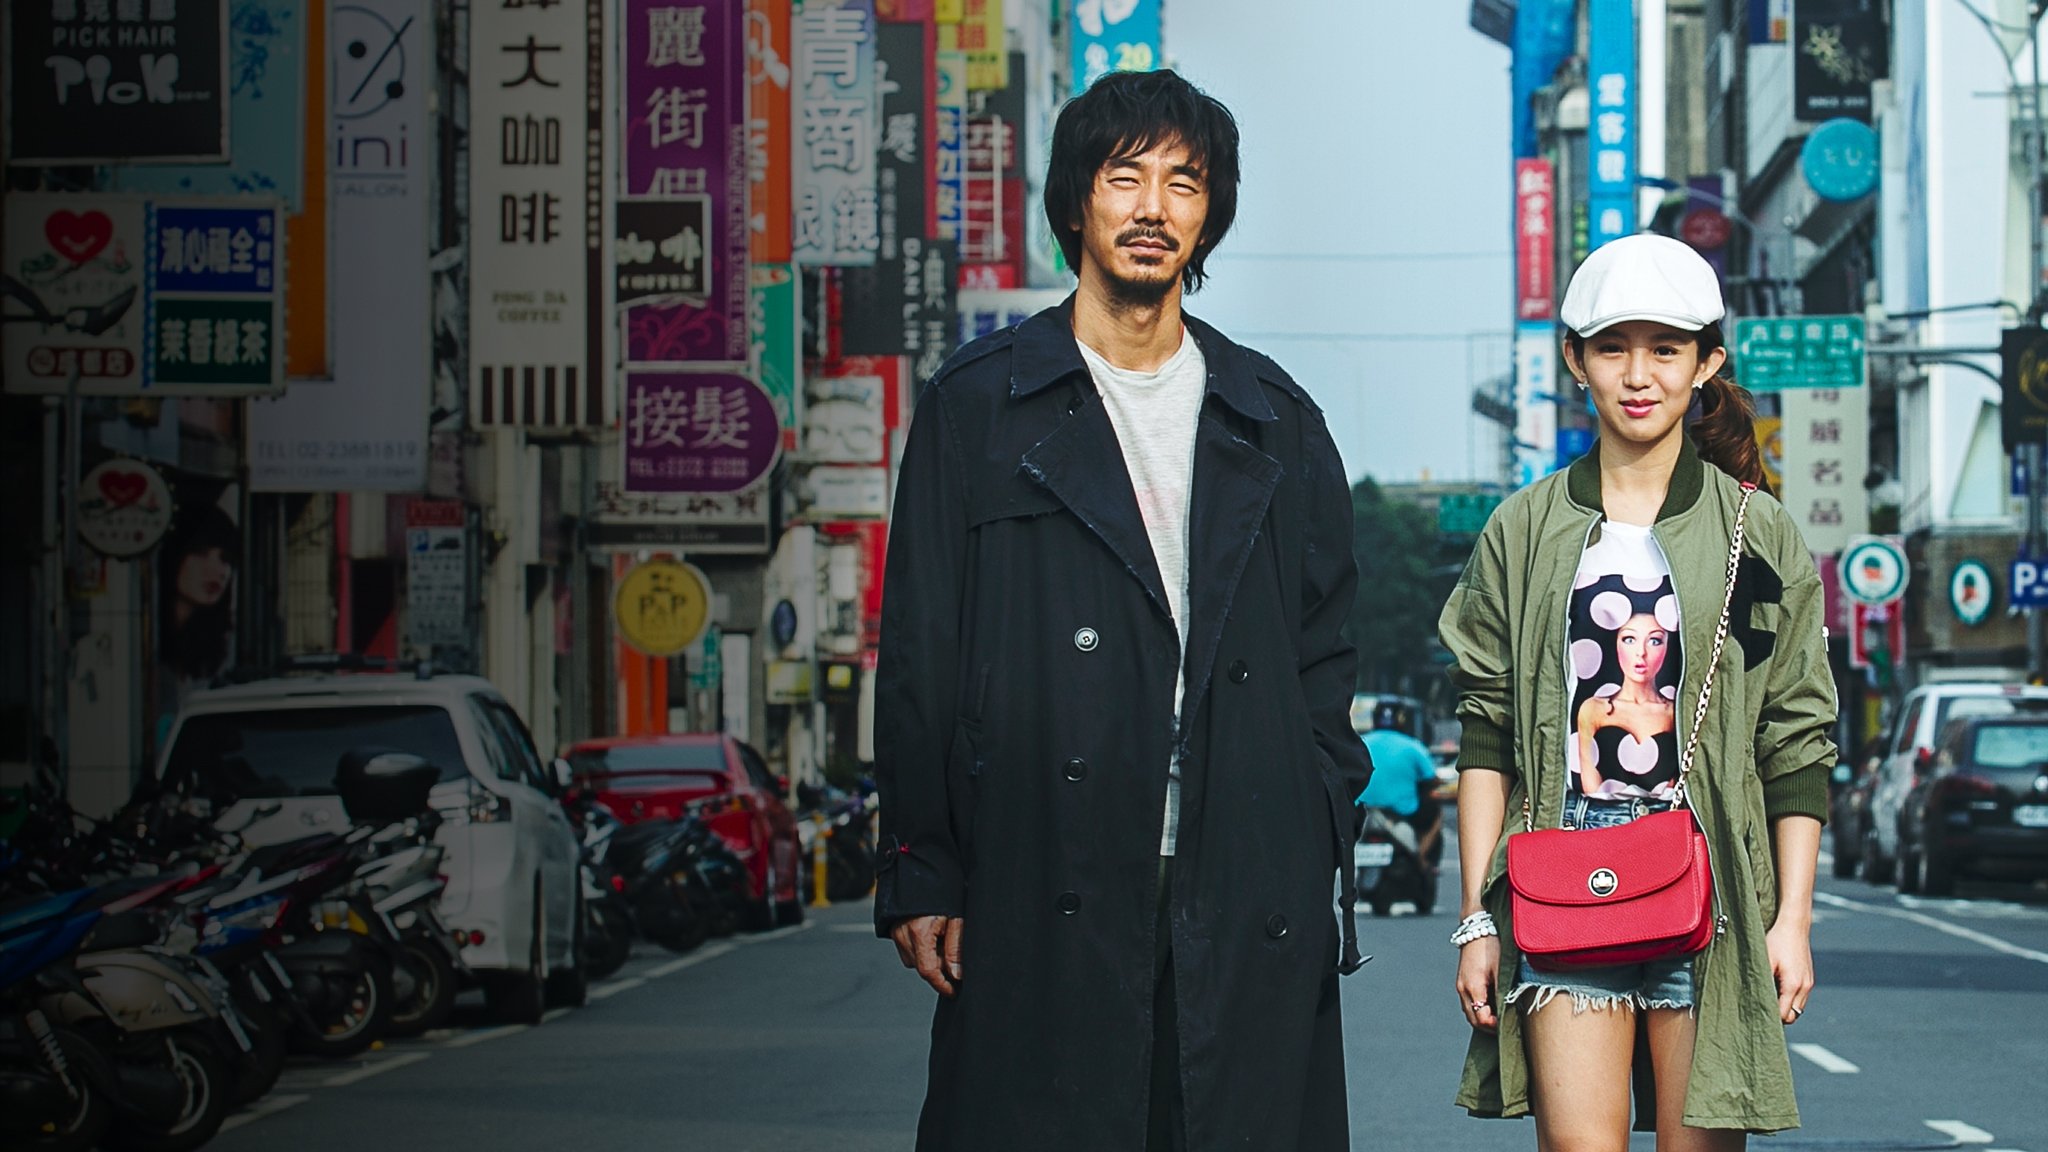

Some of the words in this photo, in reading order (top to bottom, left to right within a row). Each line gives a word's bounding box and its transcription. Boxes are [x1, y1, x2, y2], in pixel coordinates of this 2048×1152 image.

[52, 26, 112, 48] PICK
[117, 26, 177, 48] HAIR
[802, 6, 869, 173] 青商
[500, 0, 561, 244] 大咖啡
[630, 385, 751, 450] 接髮
